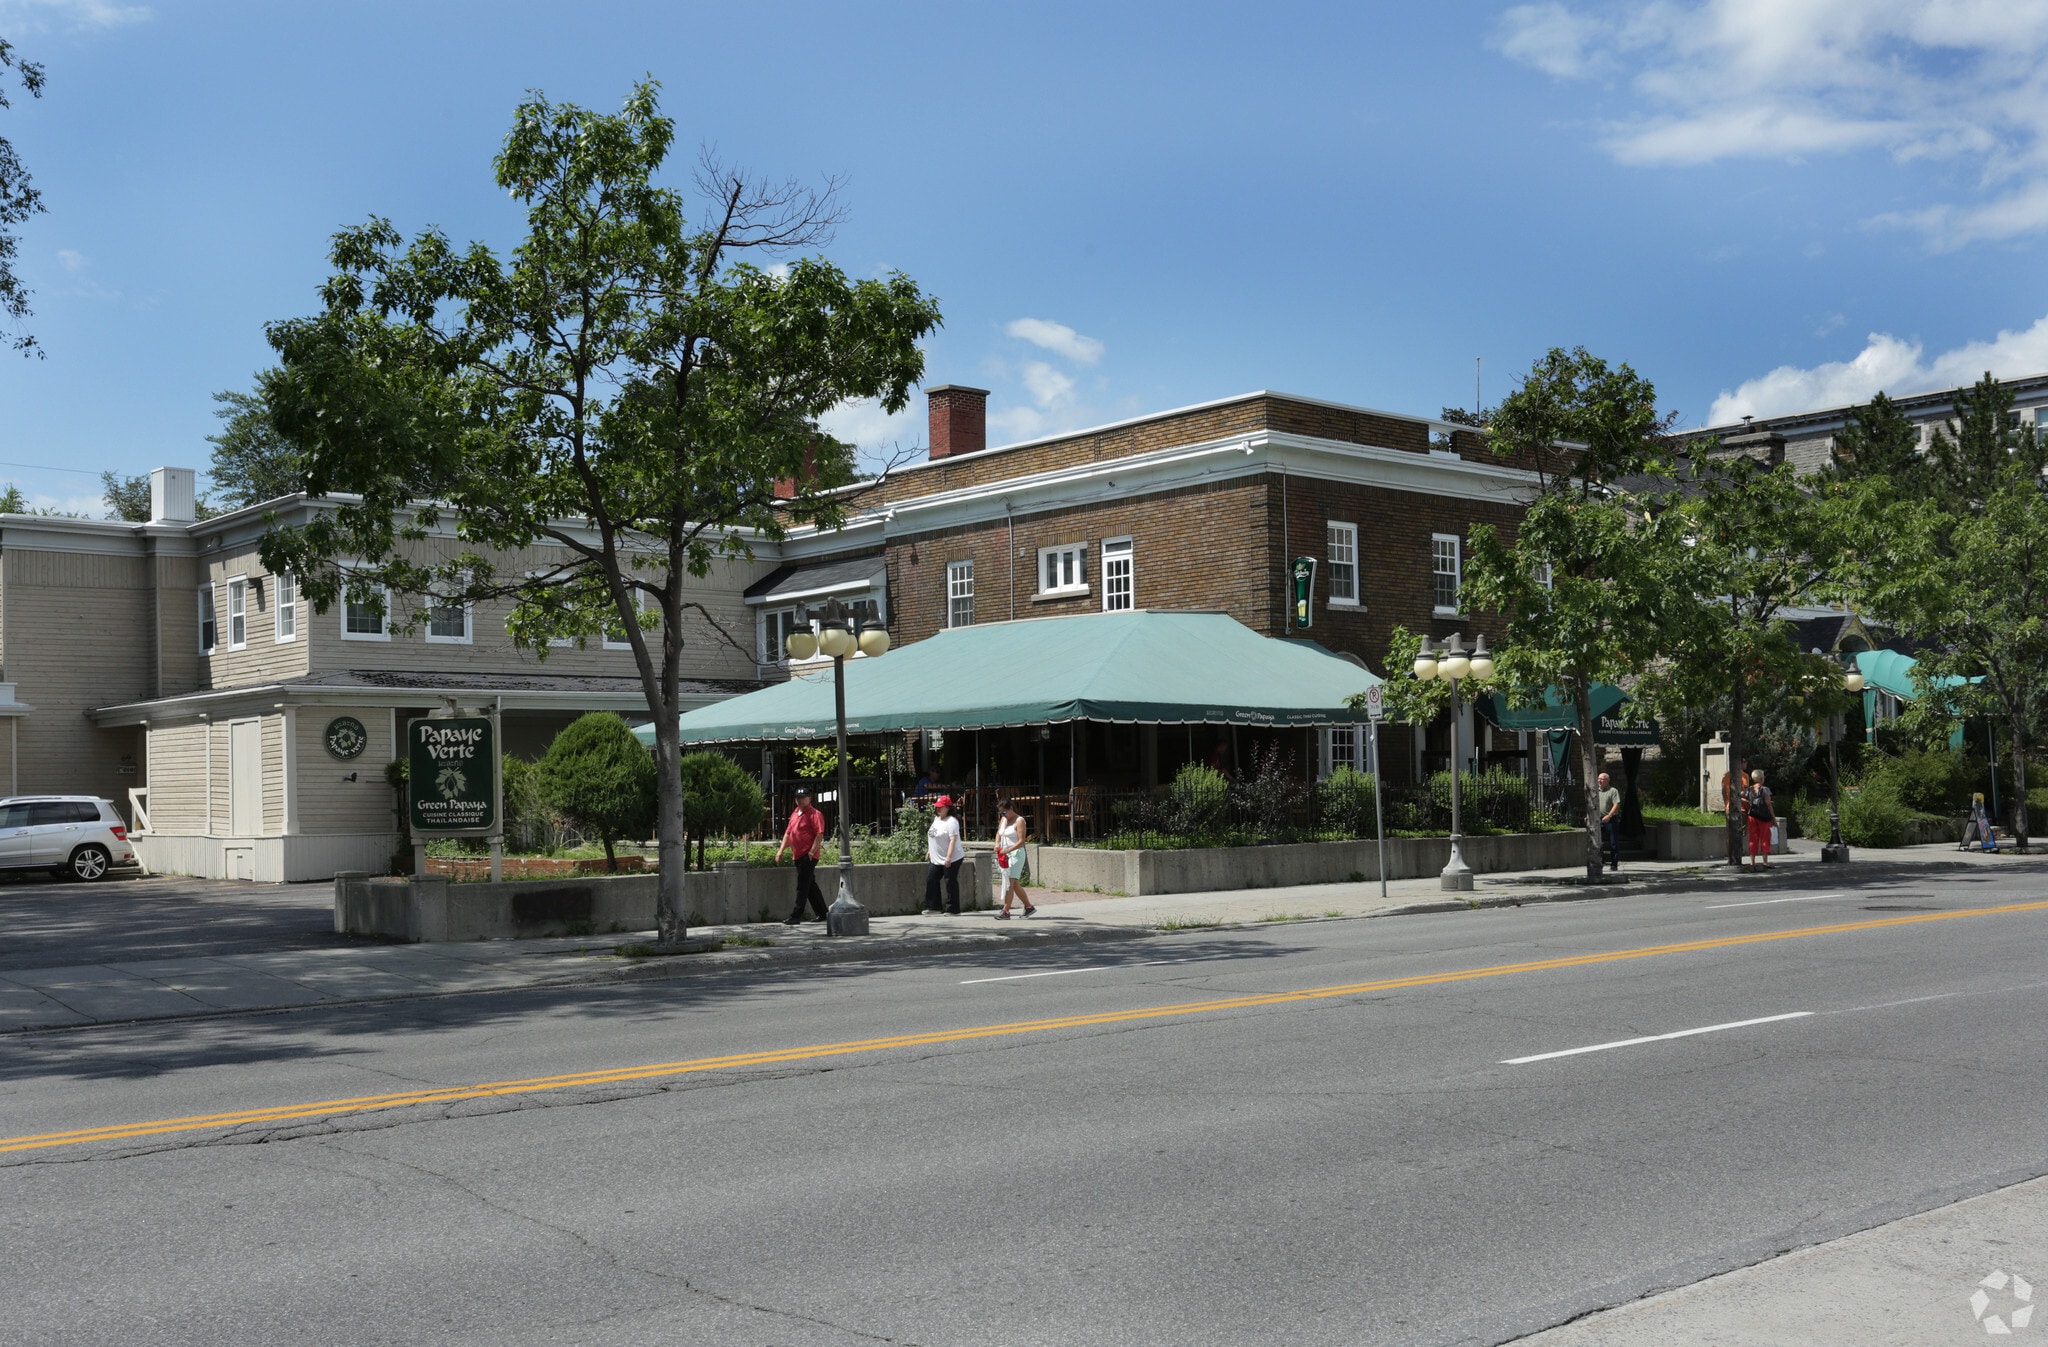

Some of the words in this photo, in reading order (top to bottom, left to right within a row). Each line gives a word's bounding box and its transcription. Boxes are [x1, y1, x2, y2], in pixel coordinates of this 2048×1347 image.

[419, 725, 483, 745] Papaye
[427, 744, 475, 760] Verte
[417, 799, 447, 810] Green
[449, 799, 488, 811] Papaya
